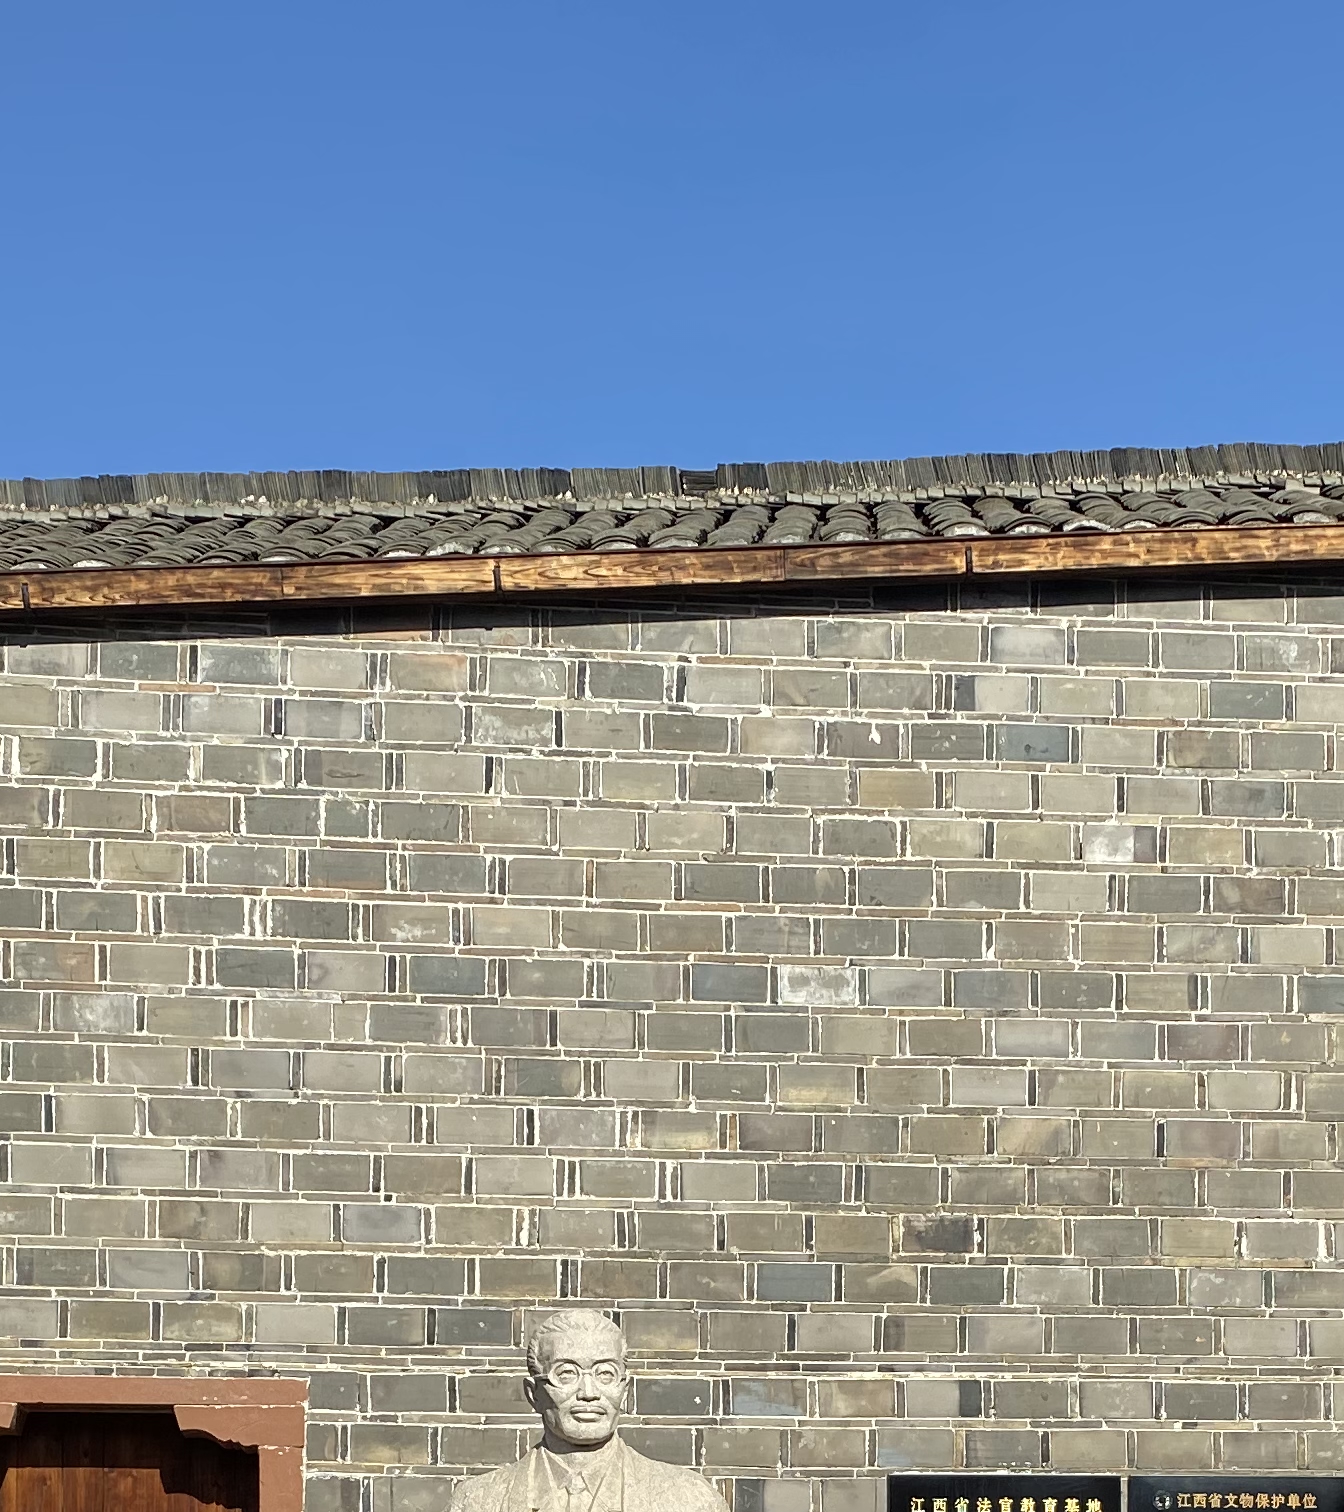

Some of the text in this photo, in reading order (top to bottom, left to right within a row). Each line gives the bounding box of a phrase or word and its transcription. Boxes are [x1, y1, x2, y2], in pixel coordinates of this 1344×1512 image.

[1176, 1492, 1318, 1510] 江西省文物保护单位
